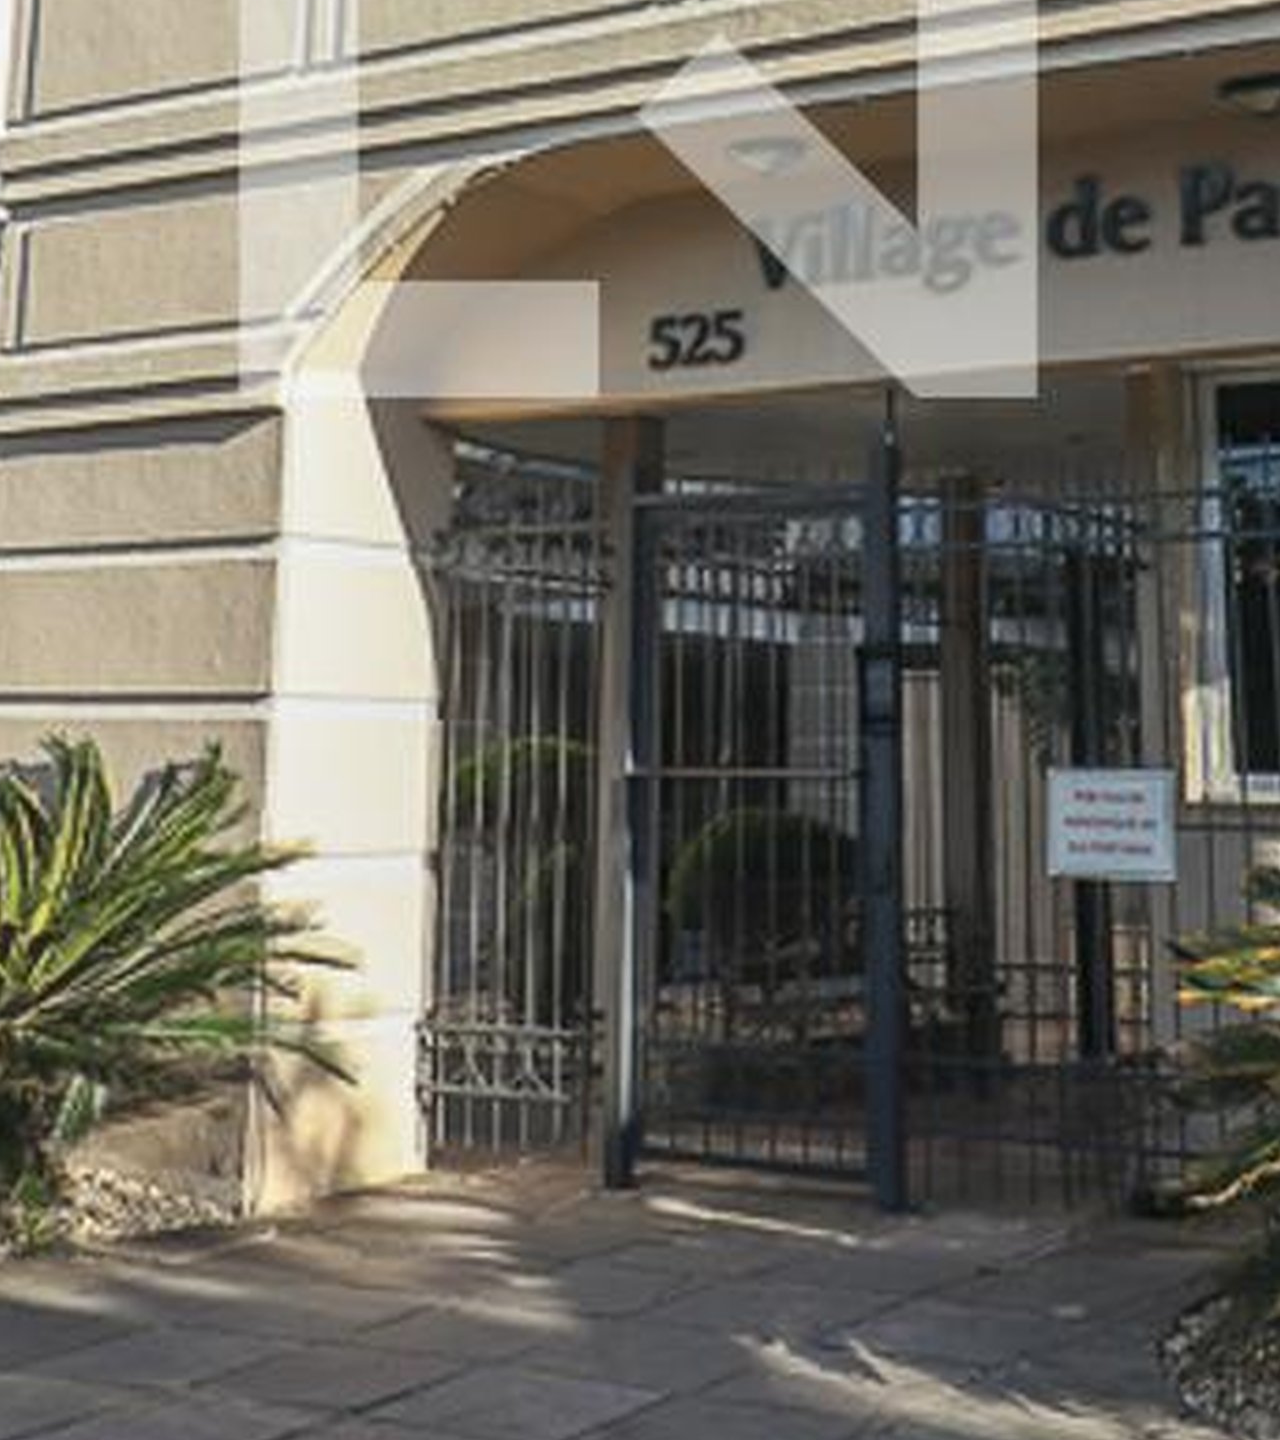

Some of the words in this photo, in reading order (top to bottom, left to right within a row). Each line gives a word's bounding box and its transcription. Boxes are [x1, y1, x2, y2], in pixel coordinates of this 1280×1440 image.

[754, 199, 1023, 295] Village
[1046, 174, 1152, 260] de
[648, 309, 746, 371] 525
